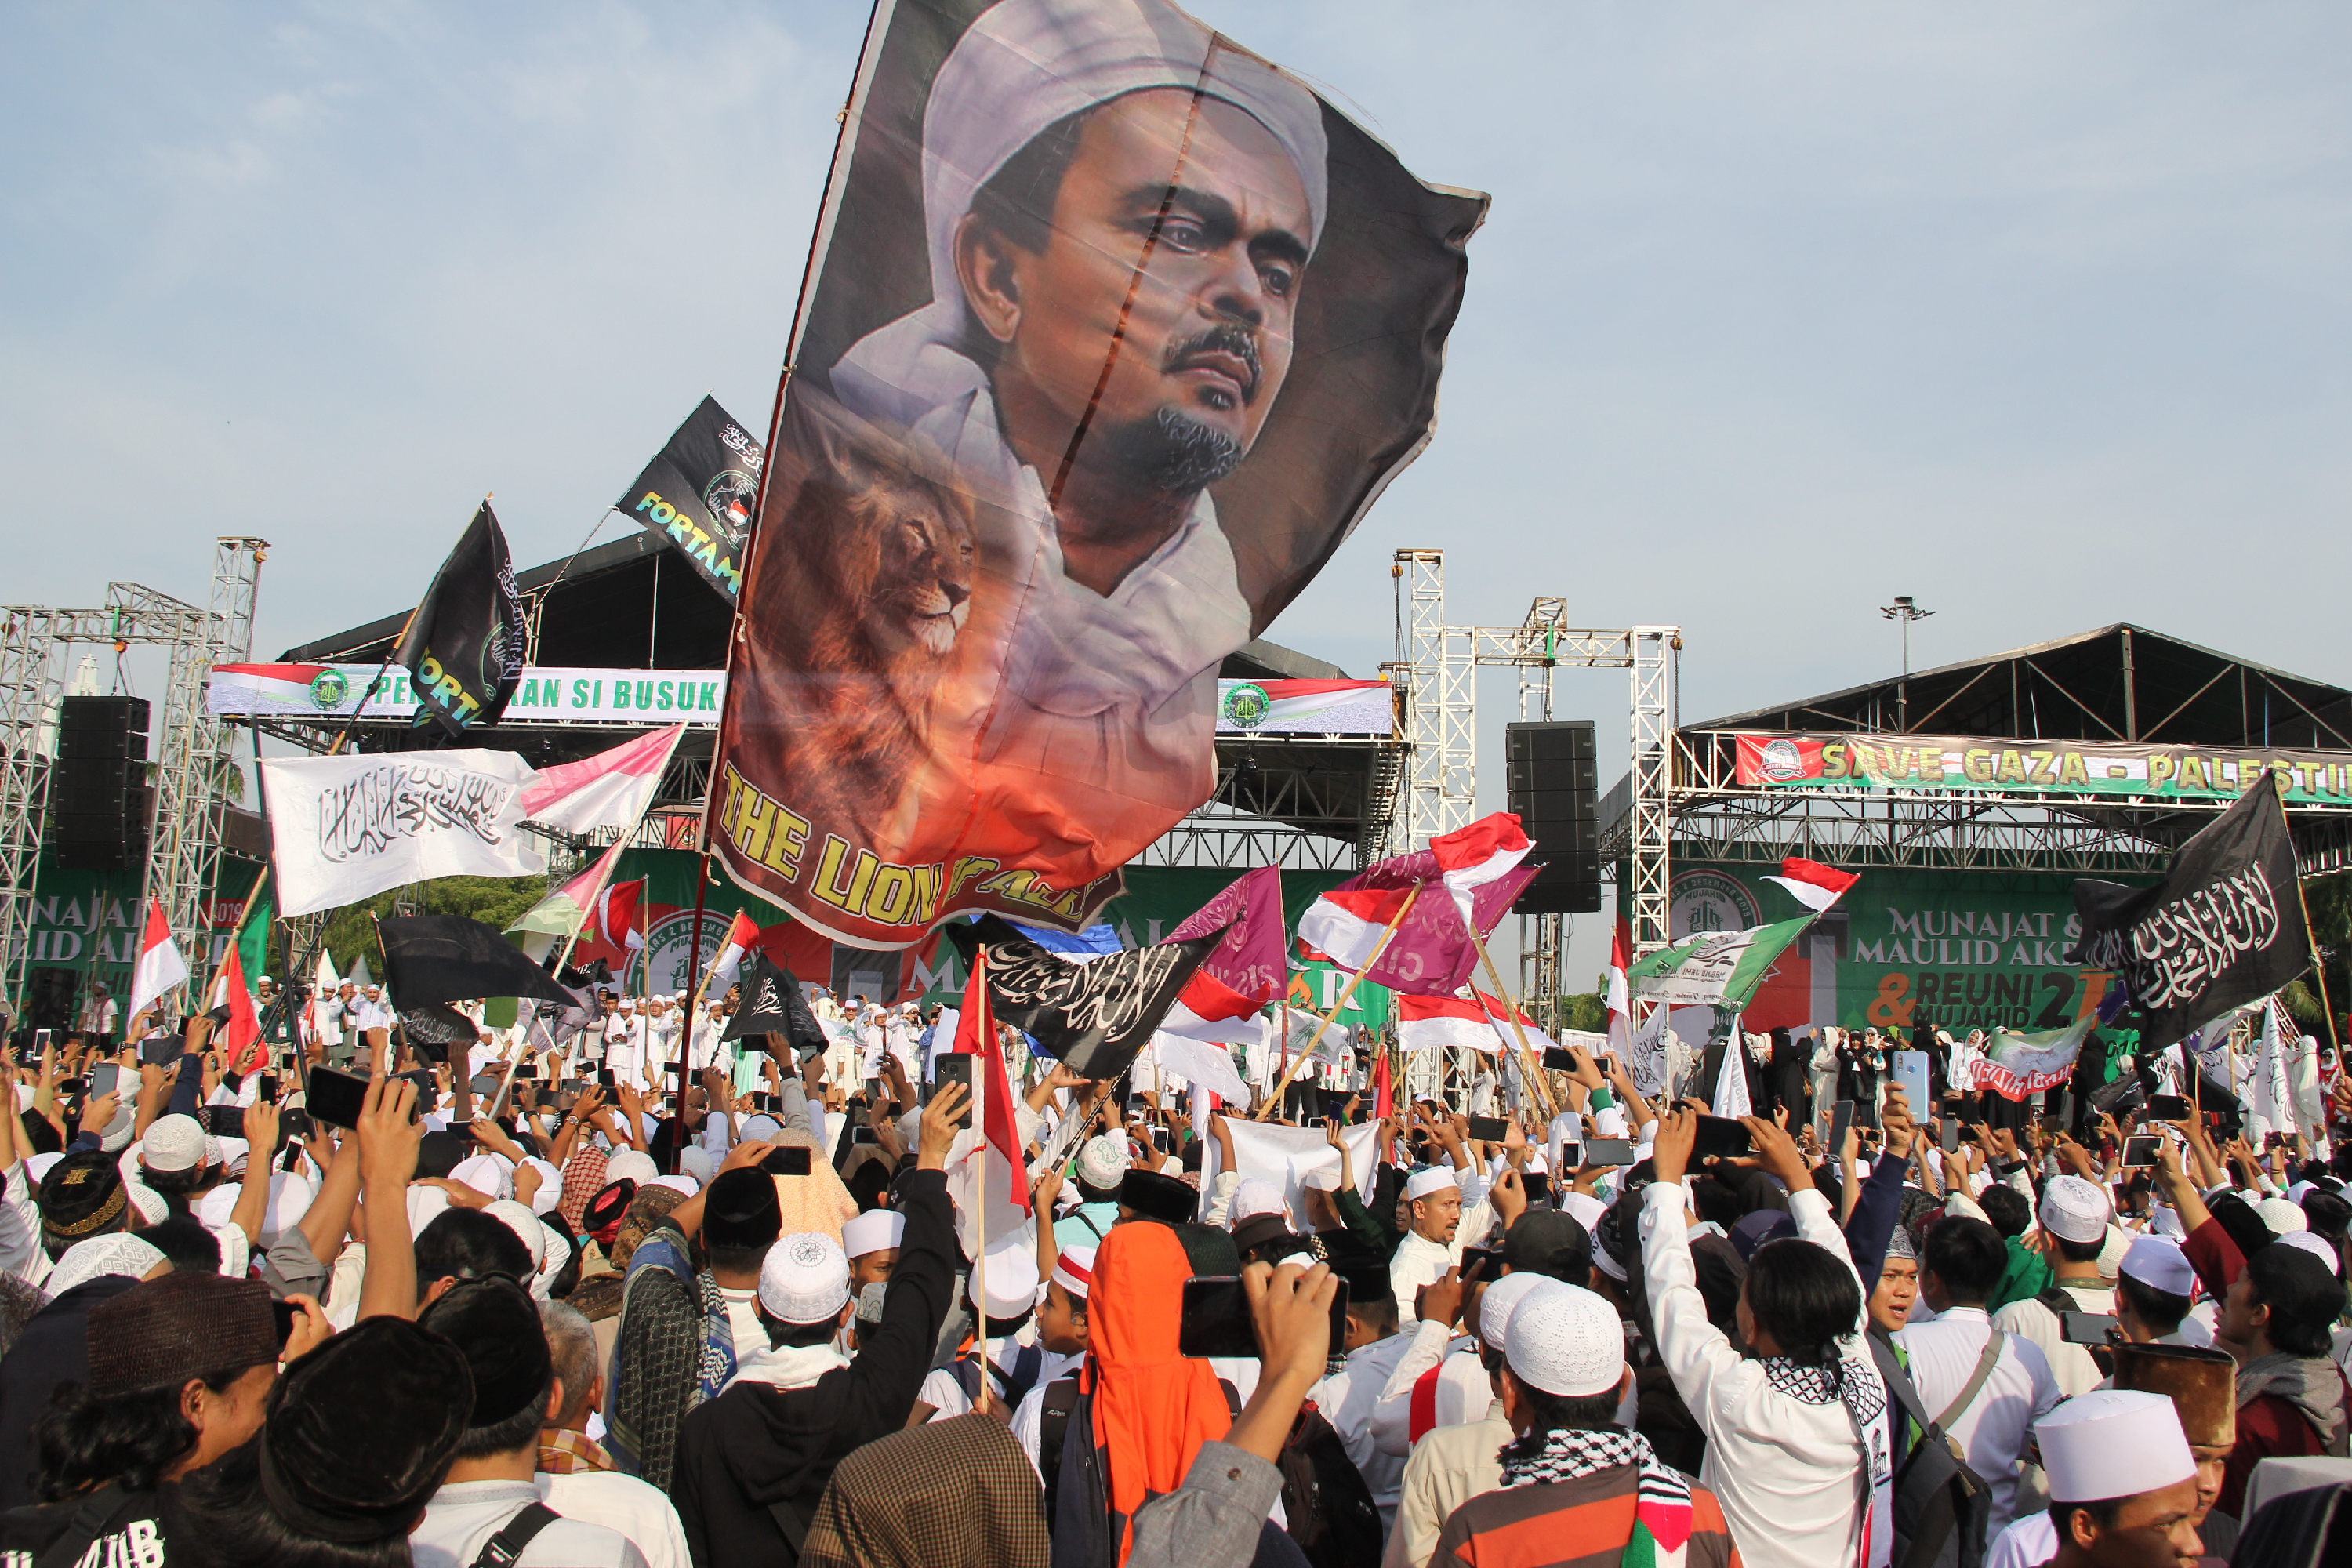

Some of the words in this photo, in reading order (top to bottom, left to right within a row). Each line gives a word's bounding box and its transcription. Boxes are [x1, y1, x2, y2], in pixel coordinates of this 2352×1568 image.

[572, 679, 602, 710] SI
[613, 680, 720, 712] BUSUK
[1821, 744, 1944, 782] SAVE
[1964, 748, 2092, 787] GAZA
[720, 759, 812, 884] THE
[808, 833, 944, 927] LION
[1686, 890, 1726, 903] MUJAHID
[1886, 907, 2055, 945] MUNAJAT
[1853, 938, 2000, 966] MAULID
[1918, 971, 2034, 1007] REUNI
[1914, 1006, 2031, 1029] MUJAHID
